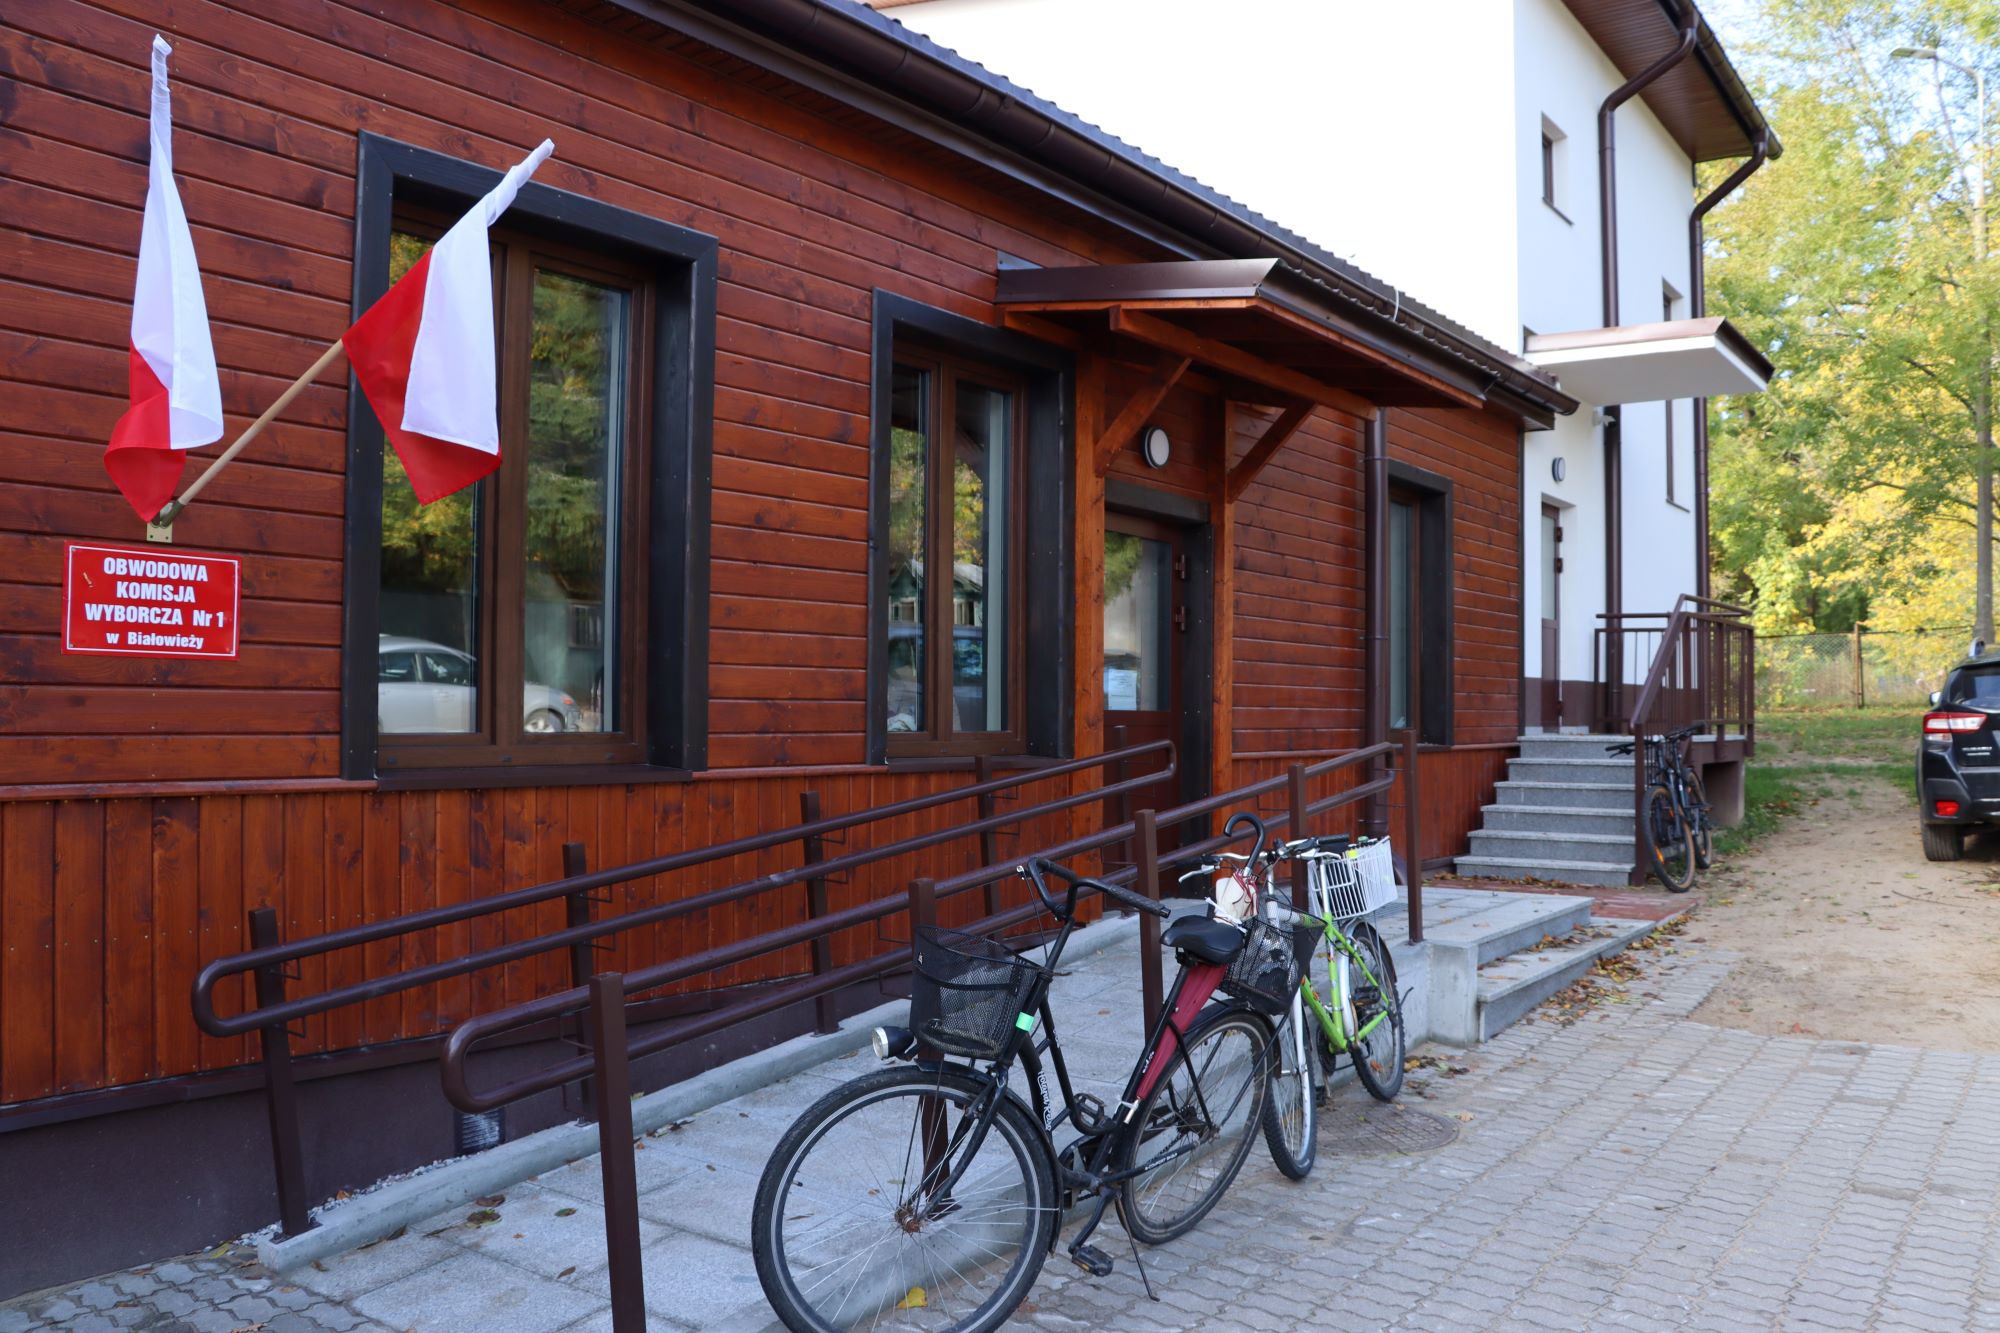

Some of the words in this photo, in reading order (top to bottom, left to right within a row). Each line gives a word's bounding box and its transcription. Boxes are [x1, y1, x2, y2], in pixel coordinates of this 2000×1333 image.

[103, 557, 208, 582] OBWODOWA
[116, 581, 196, 603] KOMISJA
[84, 603, 183, 625] WYBORCZA
[192, 610, 213, 627] Nr
[216, 611, 224, 628] 1
[105, 632, 120, 645] w
[127, 631, 204, 650] Białowieży
